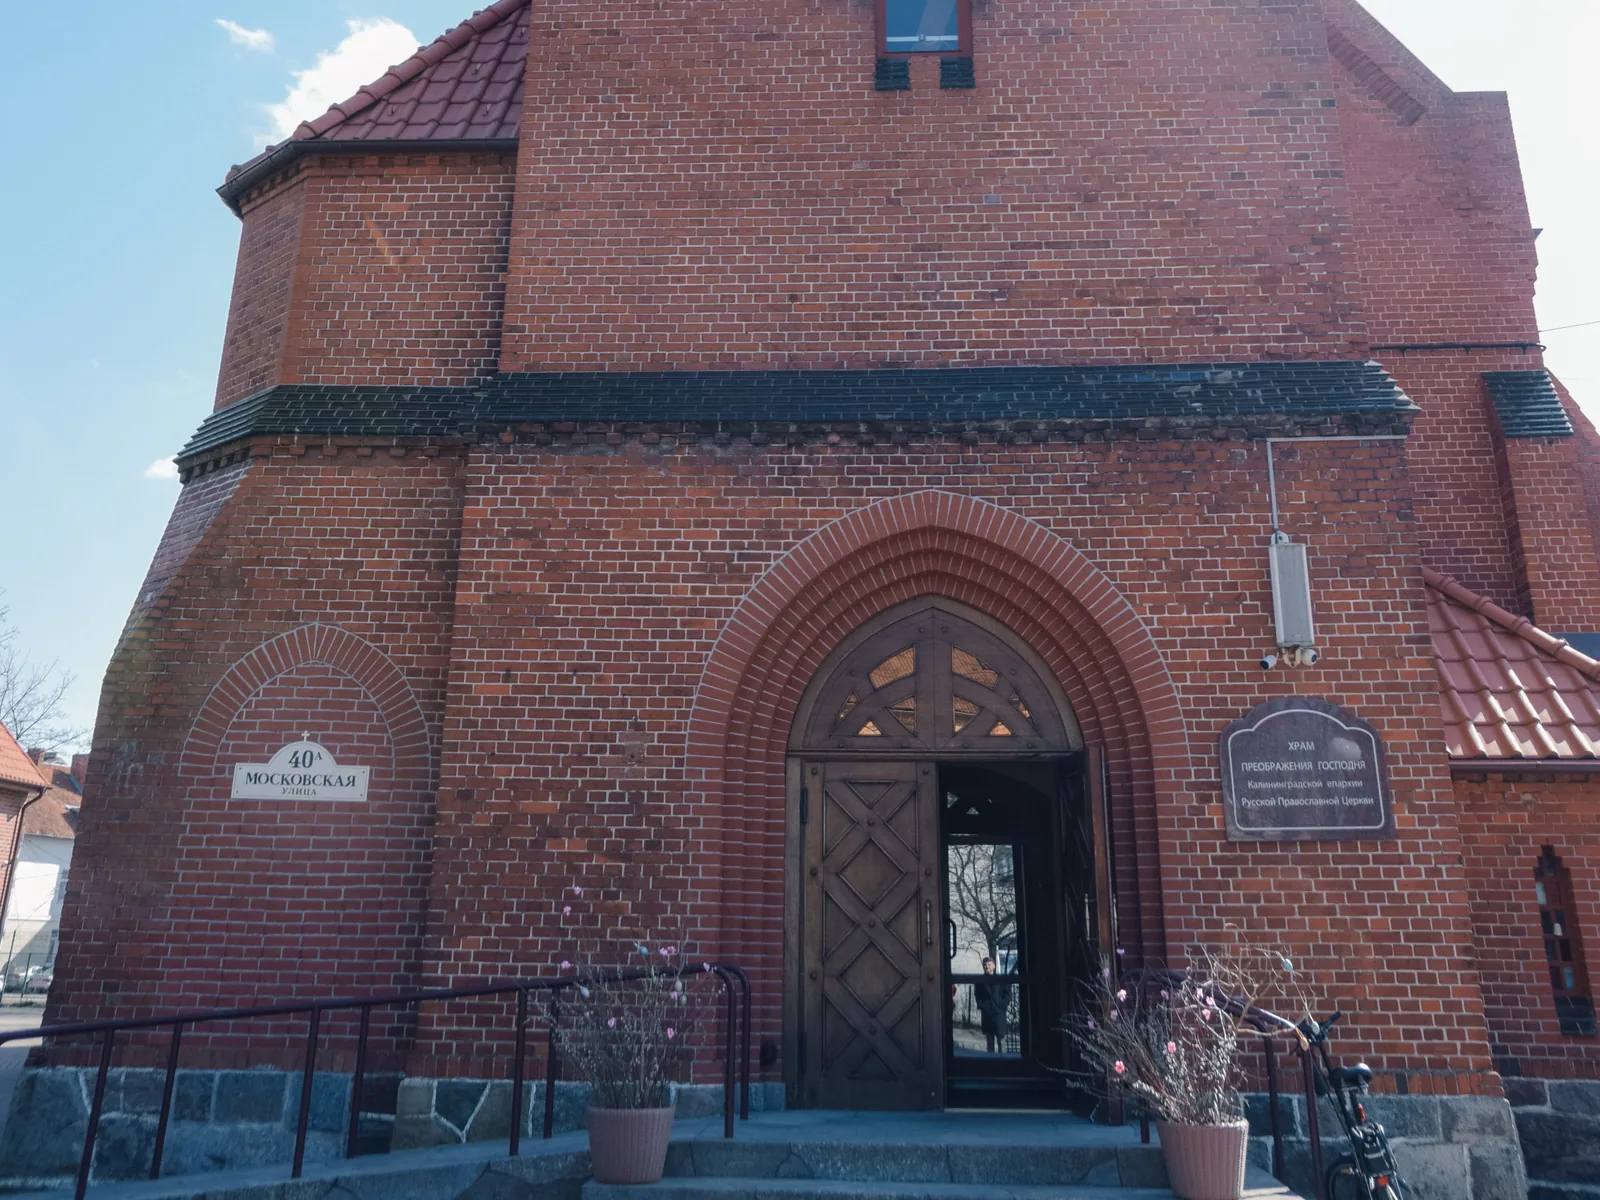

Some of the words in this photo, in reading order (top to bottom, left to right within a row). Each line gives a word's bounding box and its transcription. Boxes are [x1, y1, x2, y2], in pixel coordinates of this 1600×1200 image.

[1288, 741, 1315, 751] ХРАМ
[1241, 761, 1313, 772] ПРЕОБРАЖЕНИЯ
[1318, 760, 1366, 772] ГОСПОДНЯ
[245, 771, 356, 787] МОСКОВСКАЯ
[1247, 779, 1323, 790] Калининградской
[1327, 779, 1363, 789] епархии
[281, 787, 317, 796] УЛИЦА
[1241, 797, 1276, 807] Русской
[1277, 796, 1340, 807] Православной
[1342, 796, 1374, 807] Церкви
